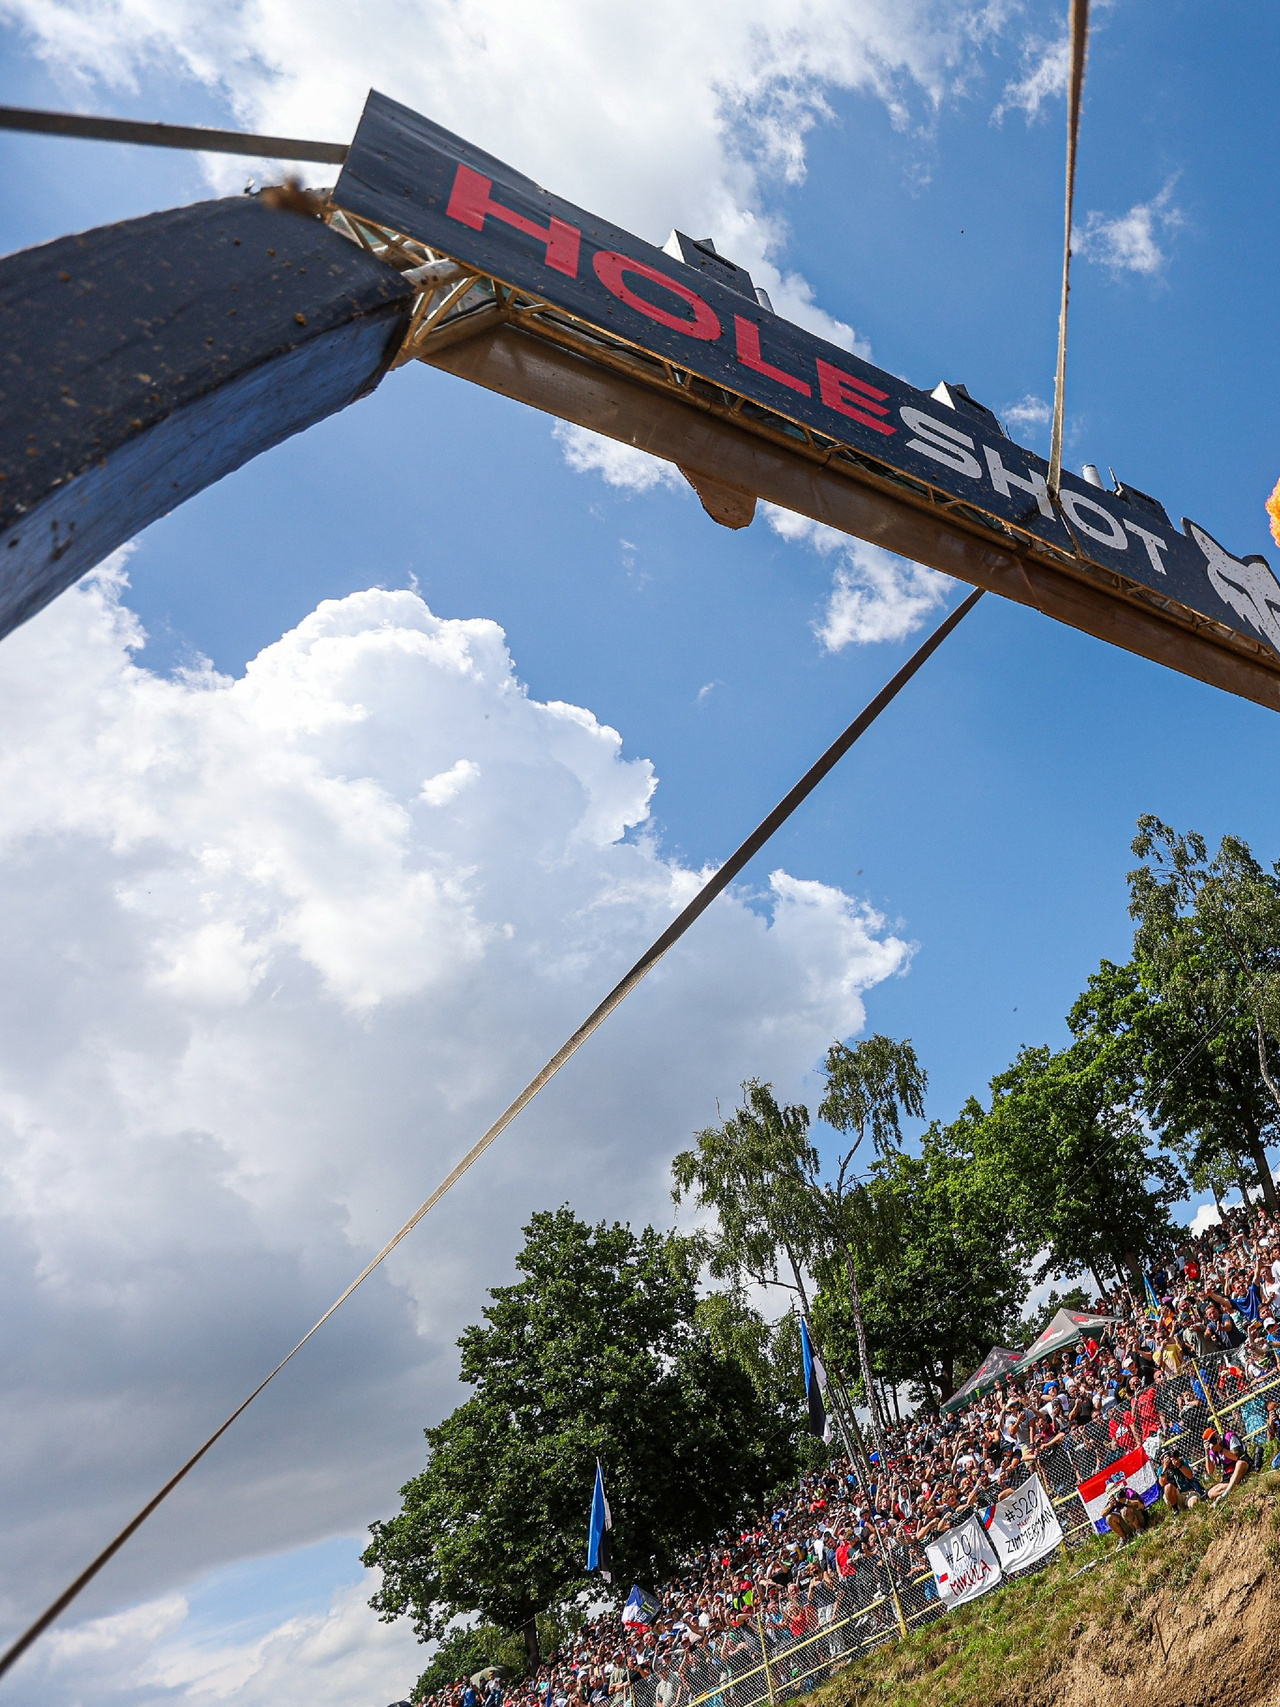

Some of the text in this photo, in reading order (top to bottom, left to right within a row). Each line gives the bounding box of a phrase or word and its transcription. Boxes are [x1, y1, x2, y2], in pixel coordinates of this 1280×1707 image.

[446, 163, 1168, 576] HOLESHOT
[1005, 1489, 1038, 1523] #520
[945, 1534, 972, 1563] #20
[949, 1559, 992, 1597] MIKULA
